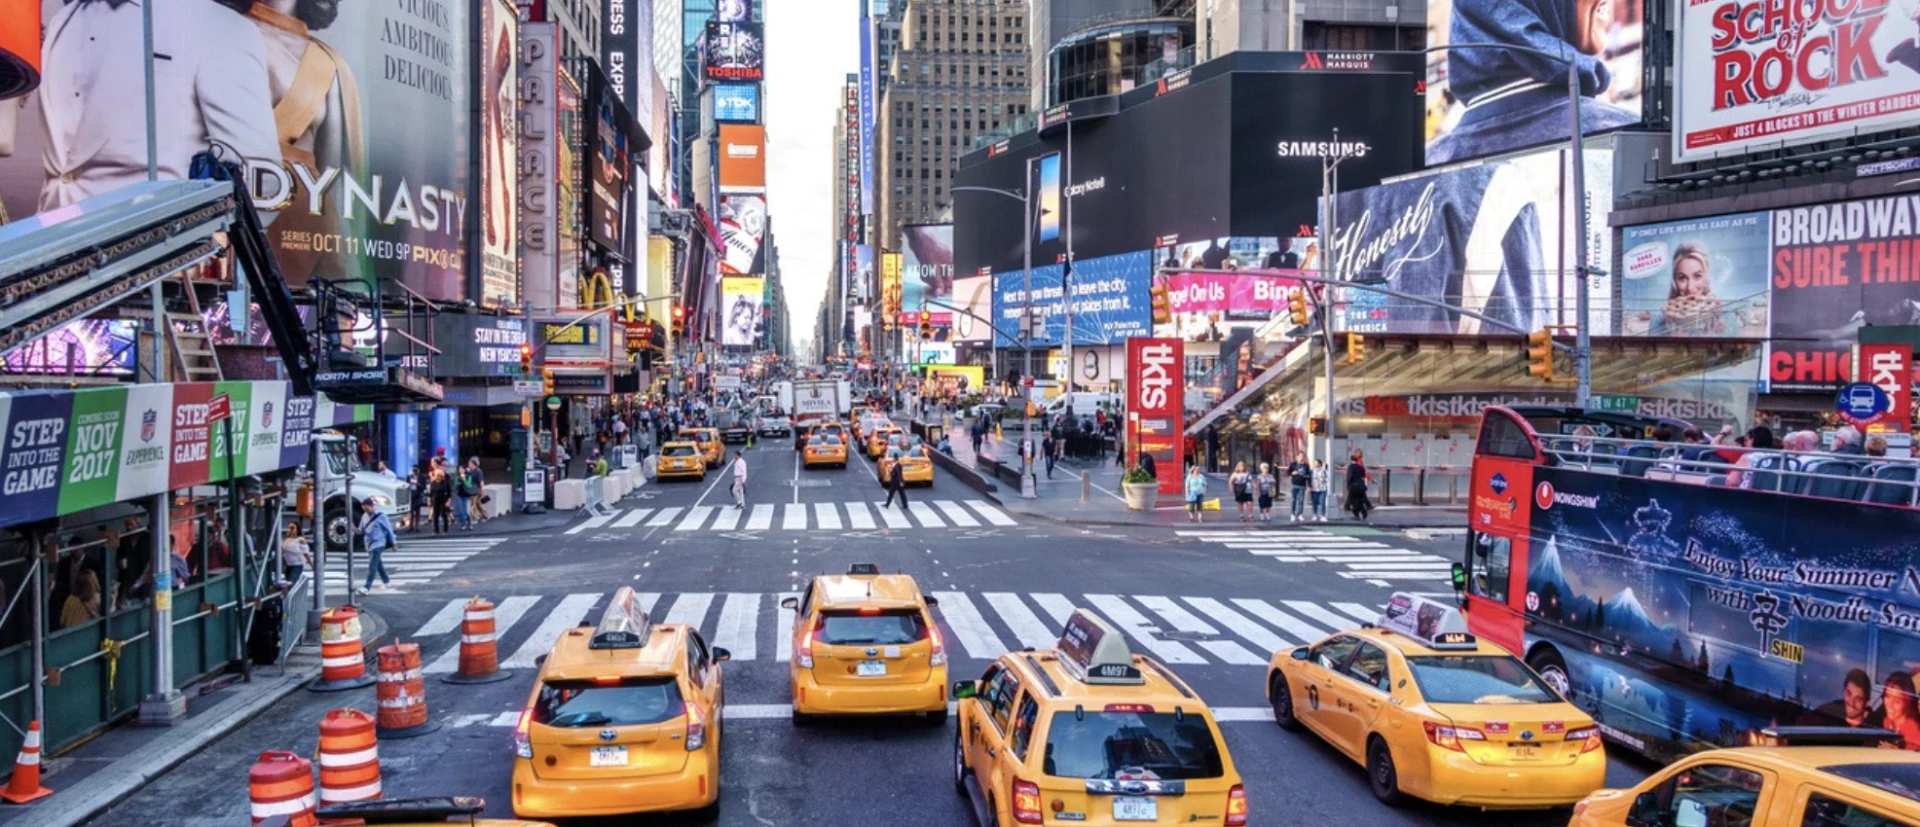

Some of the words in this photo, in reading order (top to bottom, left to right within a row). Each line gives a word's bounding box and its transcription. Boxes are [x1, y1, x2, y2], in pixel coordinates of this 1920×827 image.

[381, 17, 454, 67] AMBITIOUS
[1776, 19, 1812, 59] of
[1326, 53, 1375, 61] MARRIOTT
[1326, 61, 1369, 69] MARQUIS
[1711, 14, 1889, 112] ROCK
[384, 53, 454, 103] DELICIOUS
[707, 66, 762, 78] TOSHIBA
[1733, 123, 1756, 139] JUST
[1757, 121, 1765, 134] 4
[1765, 116, 1800, 133] BLOCKS
[1803, 113, 1814, 127] TO
[1817, 109, 1835, 124] THE
[1838, 101, 1878, 122] WINTER
[1879, 91, 1920, 114] GARDEN
[523, 38, 545, 250] PALACE
[1278, 141, 1366, 157] SAMSUNG
[246, 157, 467, 241] DYNASTY
[1334, 182, 1445, 282] Honestly
[1630, 230, 1637, 238] IF
[1639, 228, 1658, 237] ONLY
[1660, 226, 1674, 235] LIFE
[1676, 223, 1697, 233] WERE
[1699, 222, 1709, 230] AS
[1710, 219, 1730, 229] EASY
[1732, 218, 1743, 227] AS
[1744, 216, 1758, 226] PIE
[281, 230, 311, 242] SERIES
[313, 233, 341, 253] OCT
[345, 236, 359, 255] 11
[363, 238, 393, 259] WED
[395, 242, 410, 261] 9P
[907, 264, 938, 278] KNOW
[1775, 244, 1850, 289] SURE
[1031, 288, 1043, 303] you
[1079, 282, 1097, 295] leave
[1098, 279, 1110, 293] the
[1168, 286, 1188, 308] nge
[1189, 282, 1207, 301] On
[1210, 281, 1225, 302] Us
[1103, 297, 1122, 311] from
[315, 372, 350, 382] NORTH
[1140, 343, 1176, 410] tkts
[175, 403, 208, 426] STEP
[287, 399, 313, 416] STEP
[1365, 395, 1408, 417] tkts
[1603, 397, 1612, 409] W
[1615, 397, 1627, 408] 47
[11, 417, 65, 449] STEP
[73, 421, 119, 454] NOV
[175, 428, 194, 442] INTO
[194, 427, 208, 440] THE
[284, 430, 310, 448] GAME
[7, 449, 37, 469] INTO
[38, 446, 61, 464] THE
[174, 441, 208, 463] GAME
[215, 433, 245, 458] 217
[69, 449, 116, 484] 2017
[3, 464, 58, 496] GAME
[1553, 491, 1597, 509] NONGSHIM
[1684, 536, 1738, 579] Enjoy
[1741, 556, 1789, 585] Your
[1793, 560, 1899, 590] Summer
[1707, 584, 1750, 612] with
[1790, 594, 1873, 625] Noodle
[1772, 640, 1801, 662] SHIN
[1101, 665, 1128, 677] 4M97
